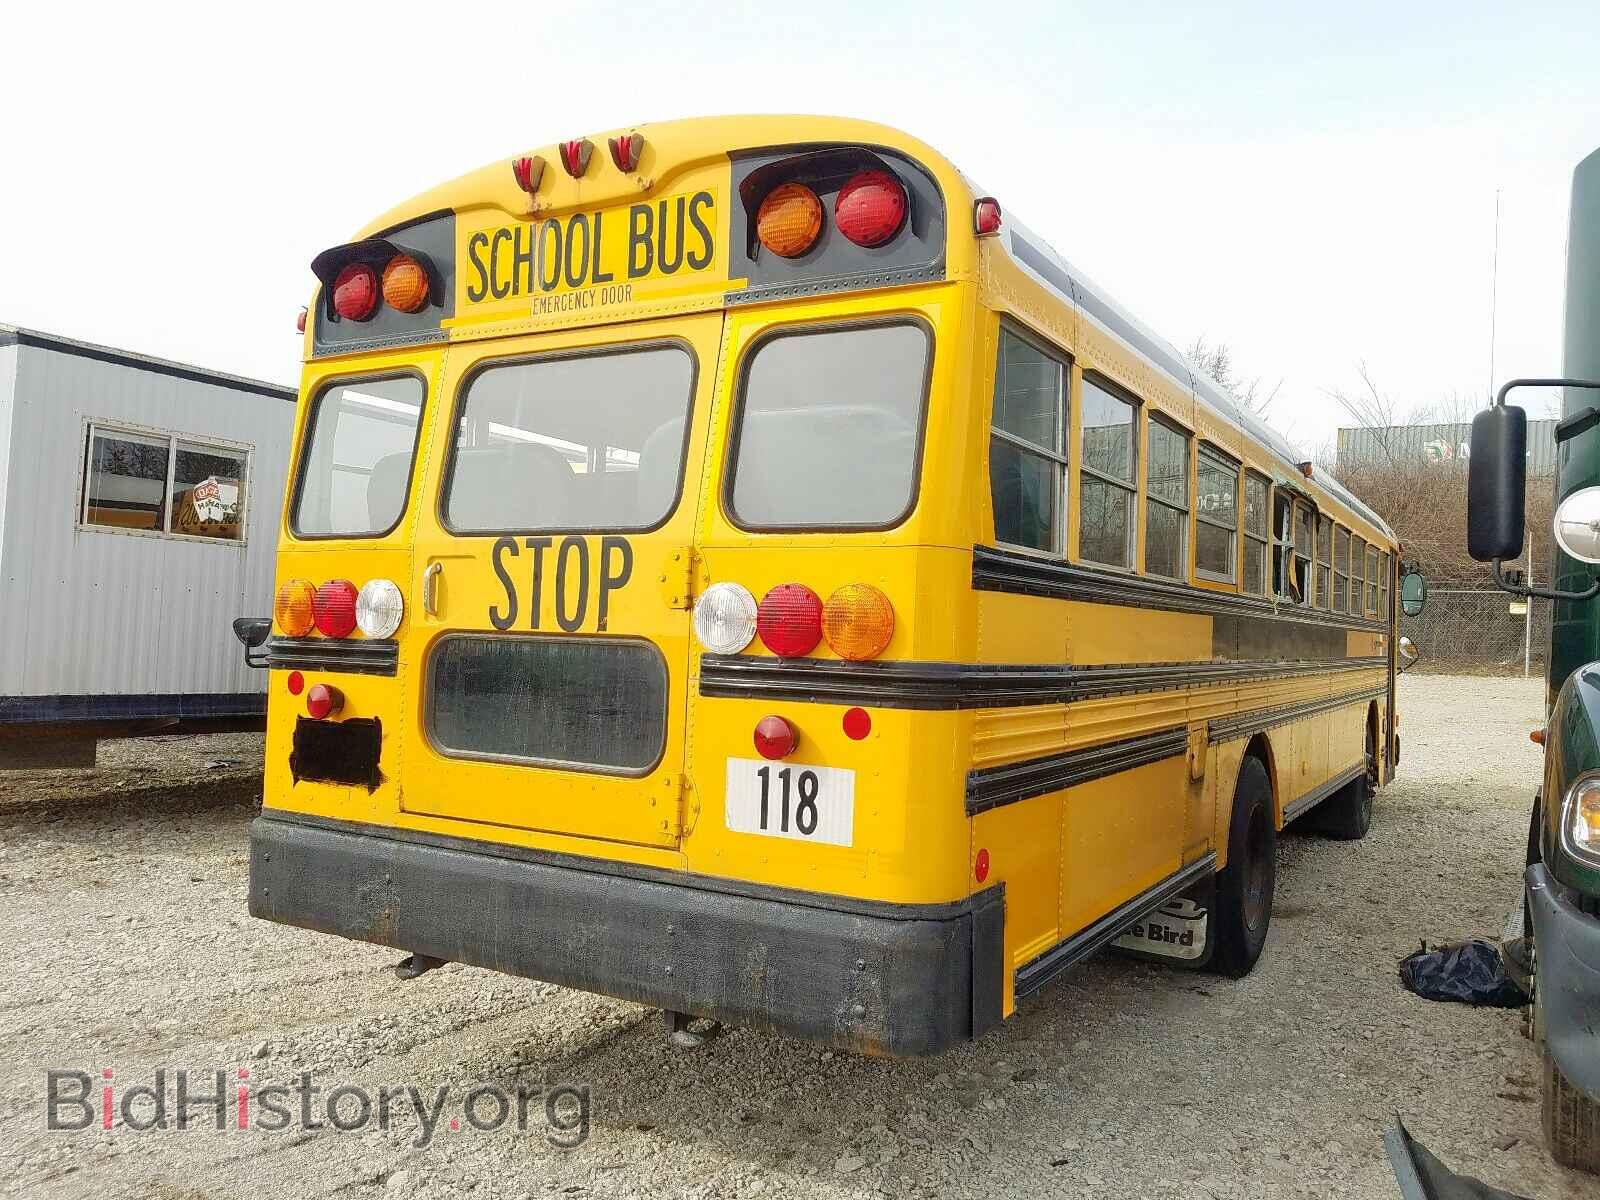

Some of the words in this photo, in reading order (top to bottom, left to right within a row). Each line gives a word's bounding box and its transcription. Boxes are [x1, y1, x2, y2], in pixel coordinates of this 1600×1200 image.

[467, 211, 613, 303] SCHOOL
[627, 191, 715, 279] BUS
[532, 290, 595, 315] EMERGENCY
[601, 284, 632, 306] DOOR
[488, 535, 634, 633] STOP
[757, 766, 819, 835] 118
[1148, 923, 1194, 947] Bird
